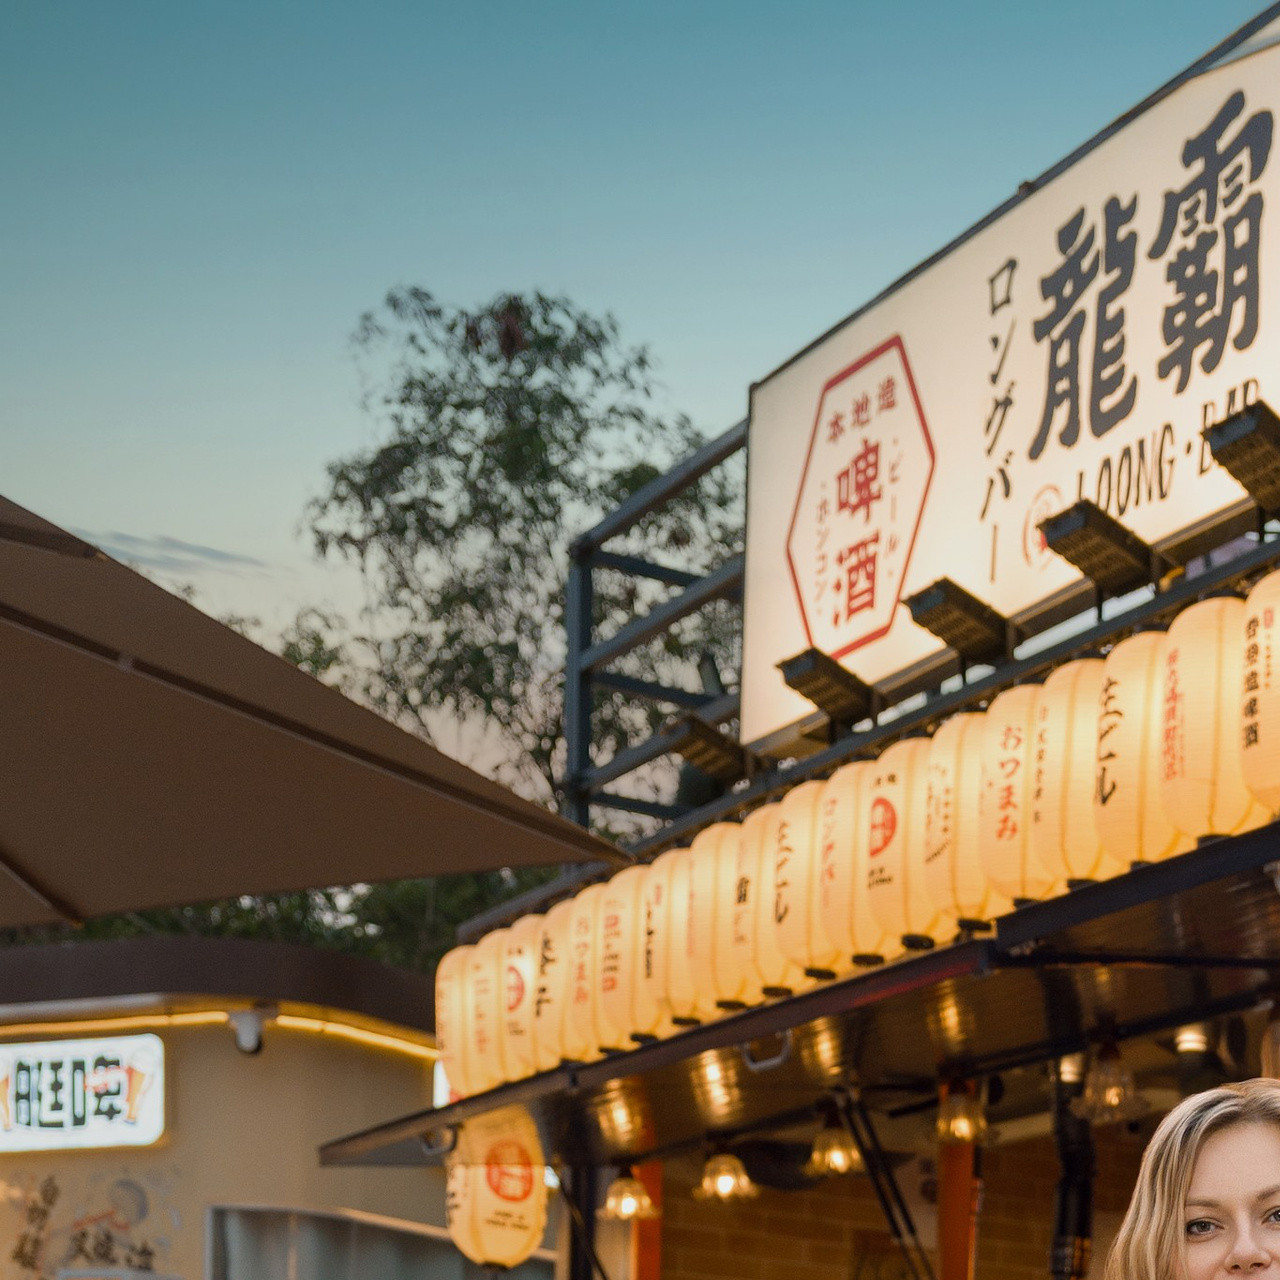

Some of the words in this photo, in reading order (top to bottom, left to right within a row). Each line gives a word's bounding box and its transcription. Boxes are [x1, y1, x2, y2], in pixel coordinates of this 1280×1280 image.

[1028, 90, 1275, 461] 龍霸
[831, 437, 882, 628] 啤酒
[980, 257, 1018, 583] ロングバー
[996, 725, 1023, 841] おつまみ
